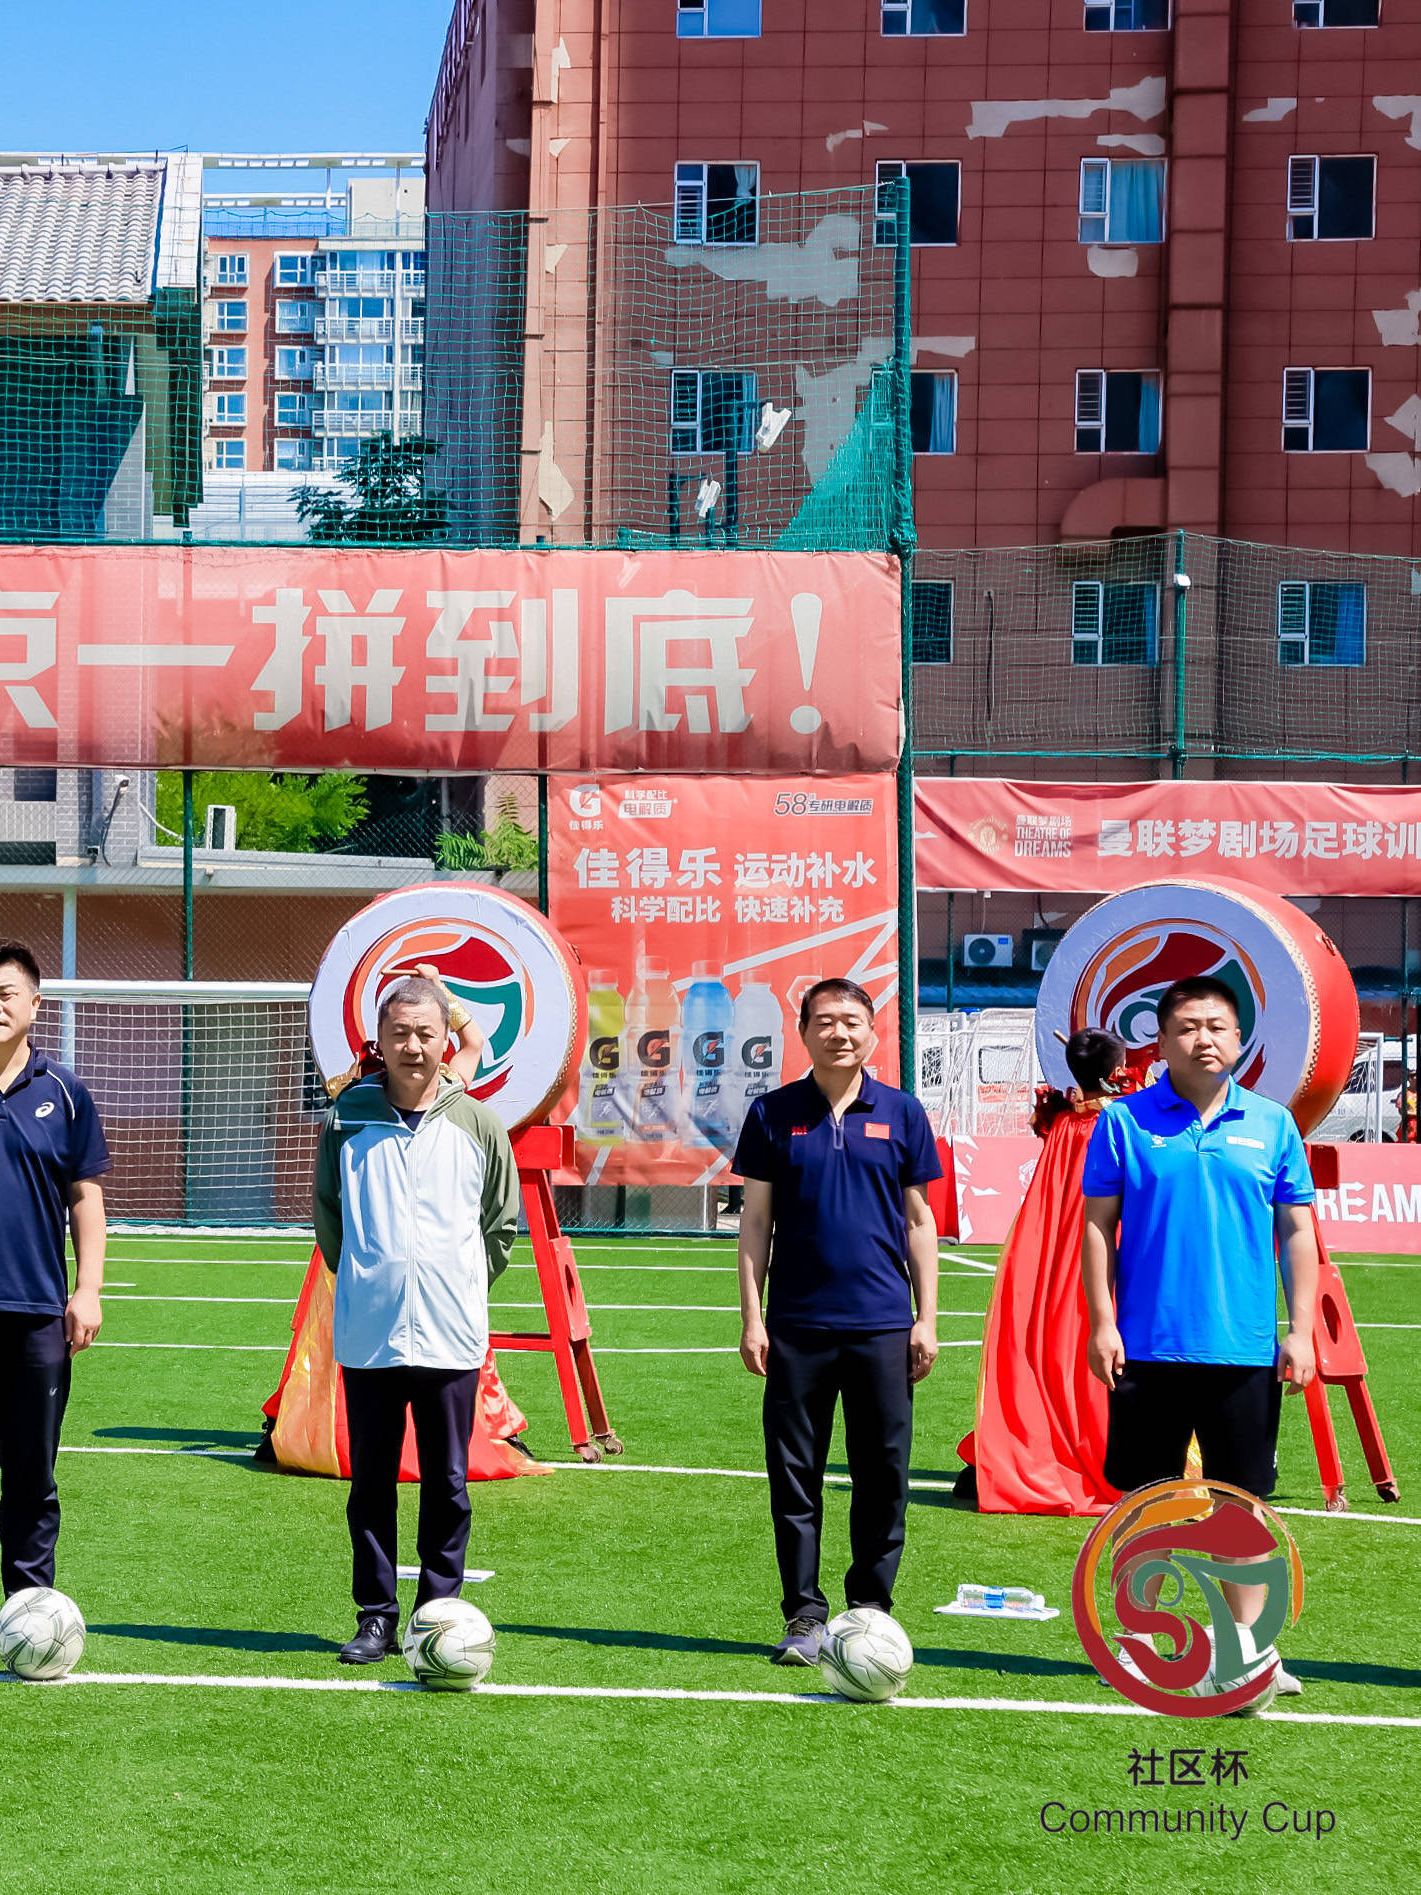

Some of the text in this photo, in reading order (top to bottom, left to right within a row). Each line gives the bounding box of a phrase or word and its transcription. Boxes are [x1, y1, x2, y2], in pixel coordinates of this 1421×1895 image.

[569, 820, 604, 831] 佳得乐
[1016, 826, 1072, 840] THEATRE OF
[1014, 840, 1072, 858] DREAMS
[1097, 819, 1421, 860] 曼联梦剧场足球训
[573, 847, 877, 889] 佳得乐 运动补水
[611, 896, 845, 923] 科学配比 快速补充
[1315, 1182, 1421, 1223] REAM
